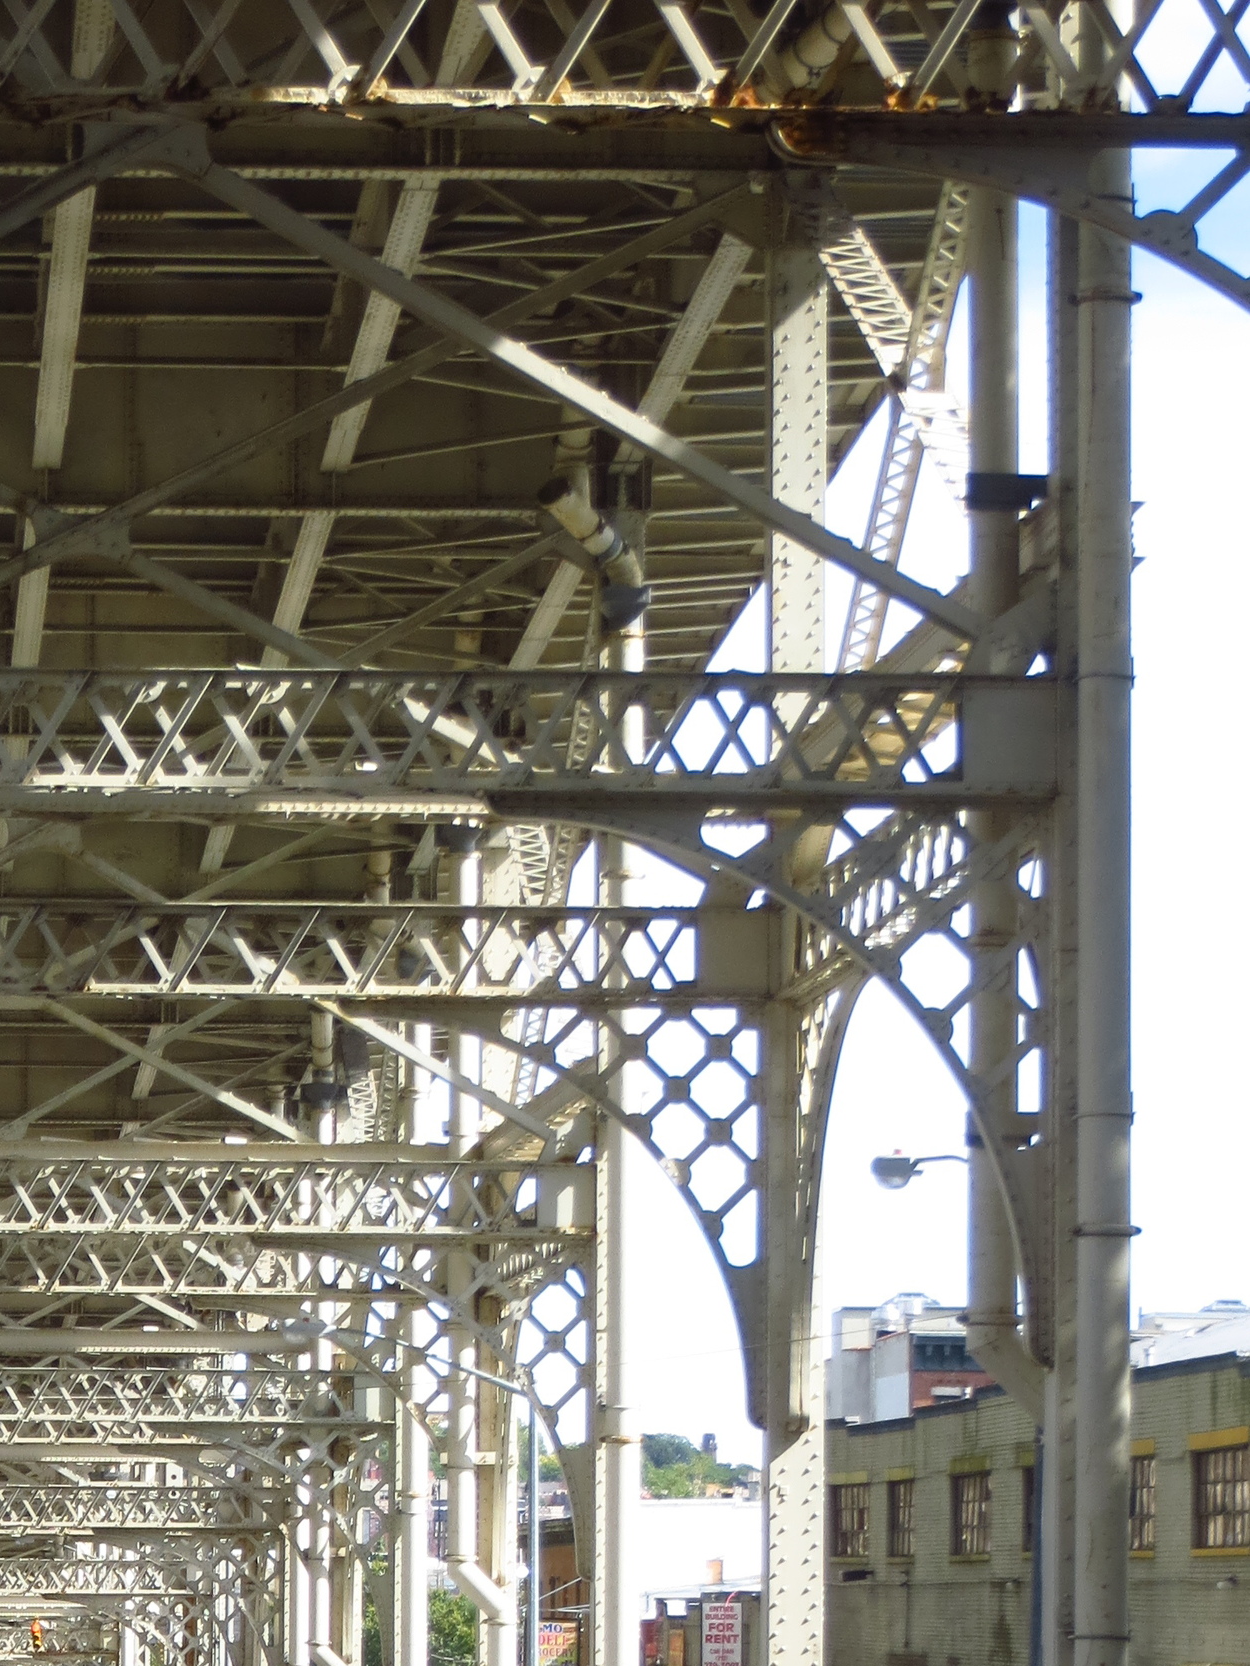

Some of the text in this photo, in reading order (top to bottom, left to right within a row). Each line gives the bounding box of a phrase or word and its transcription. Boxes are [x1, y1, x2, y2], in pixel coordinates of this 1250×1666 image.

[539, 1623, 563, 1633] MO
[708, 1622, 735, 1633] FOR
[705, 1634, 739, 1644] RENT
